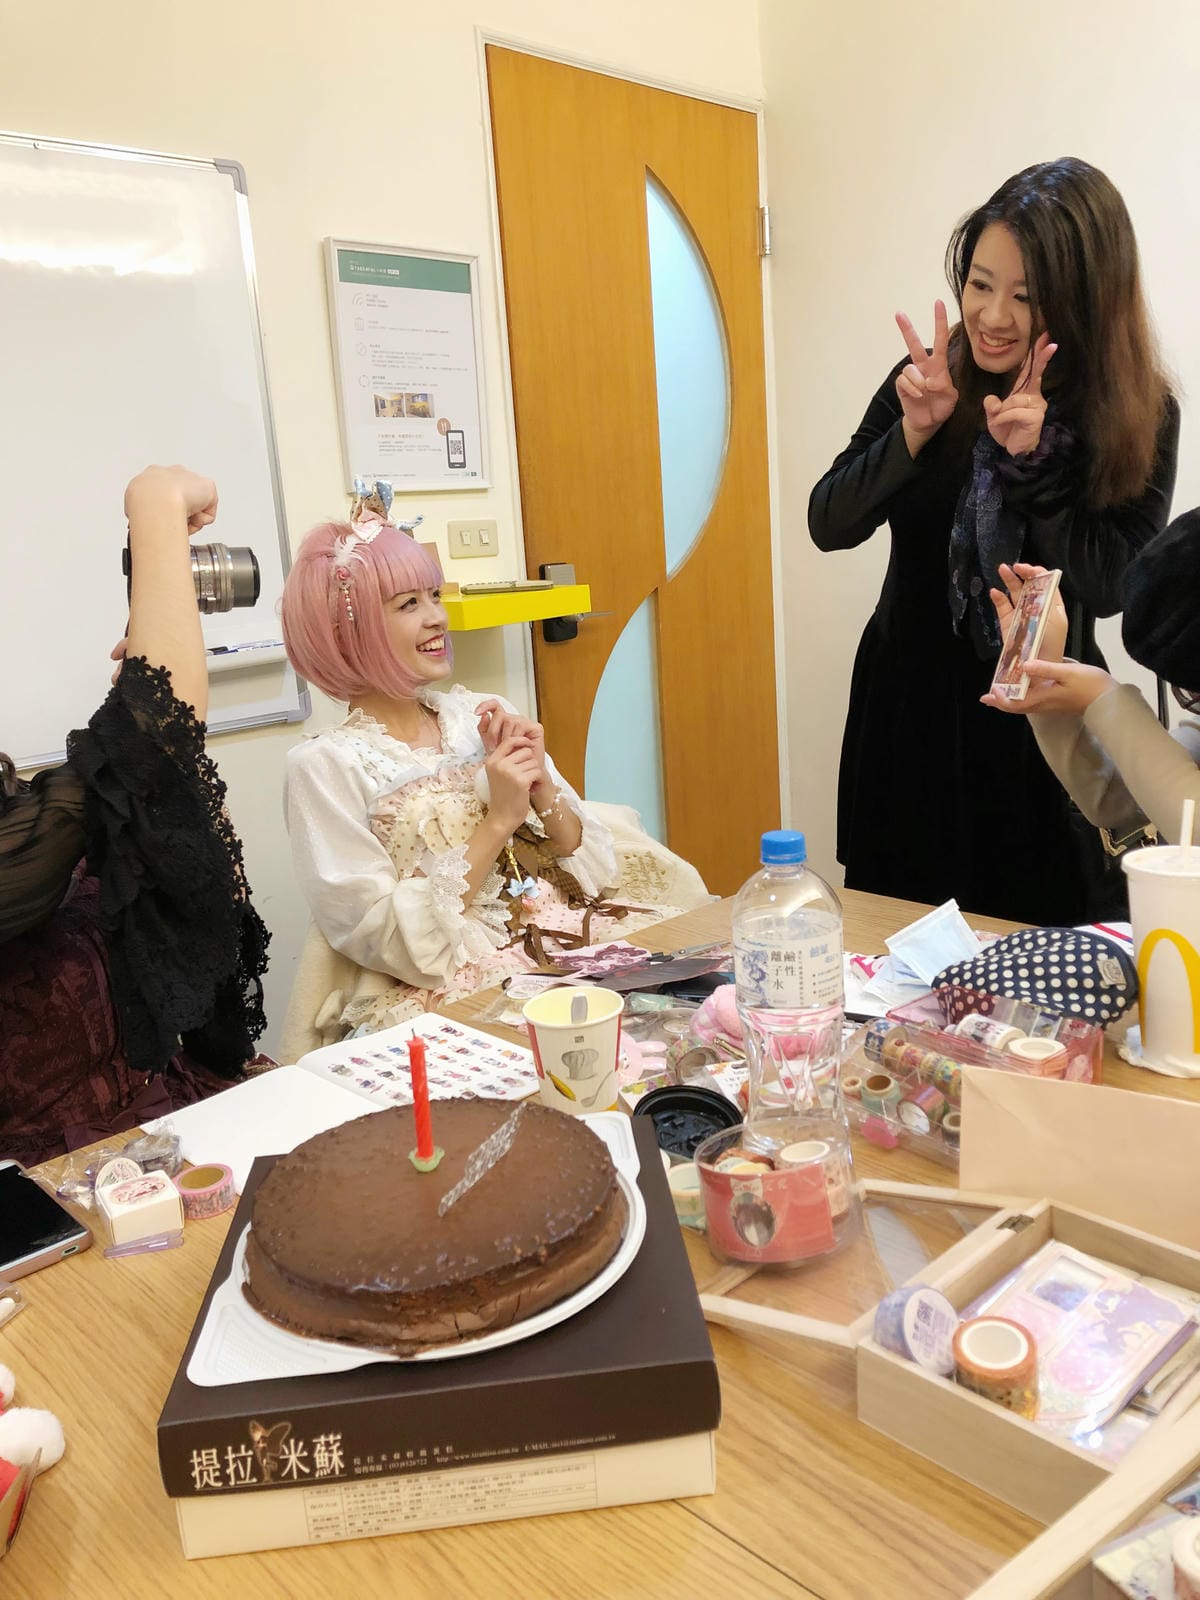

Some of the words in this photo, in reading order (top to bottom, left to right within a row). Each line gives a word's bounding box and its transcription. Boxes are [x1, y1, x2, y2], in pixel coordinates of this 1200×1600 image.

[770, 950, 784, 990] 離子水
[189, 1432, 346, 1490] 提拉米蘇
